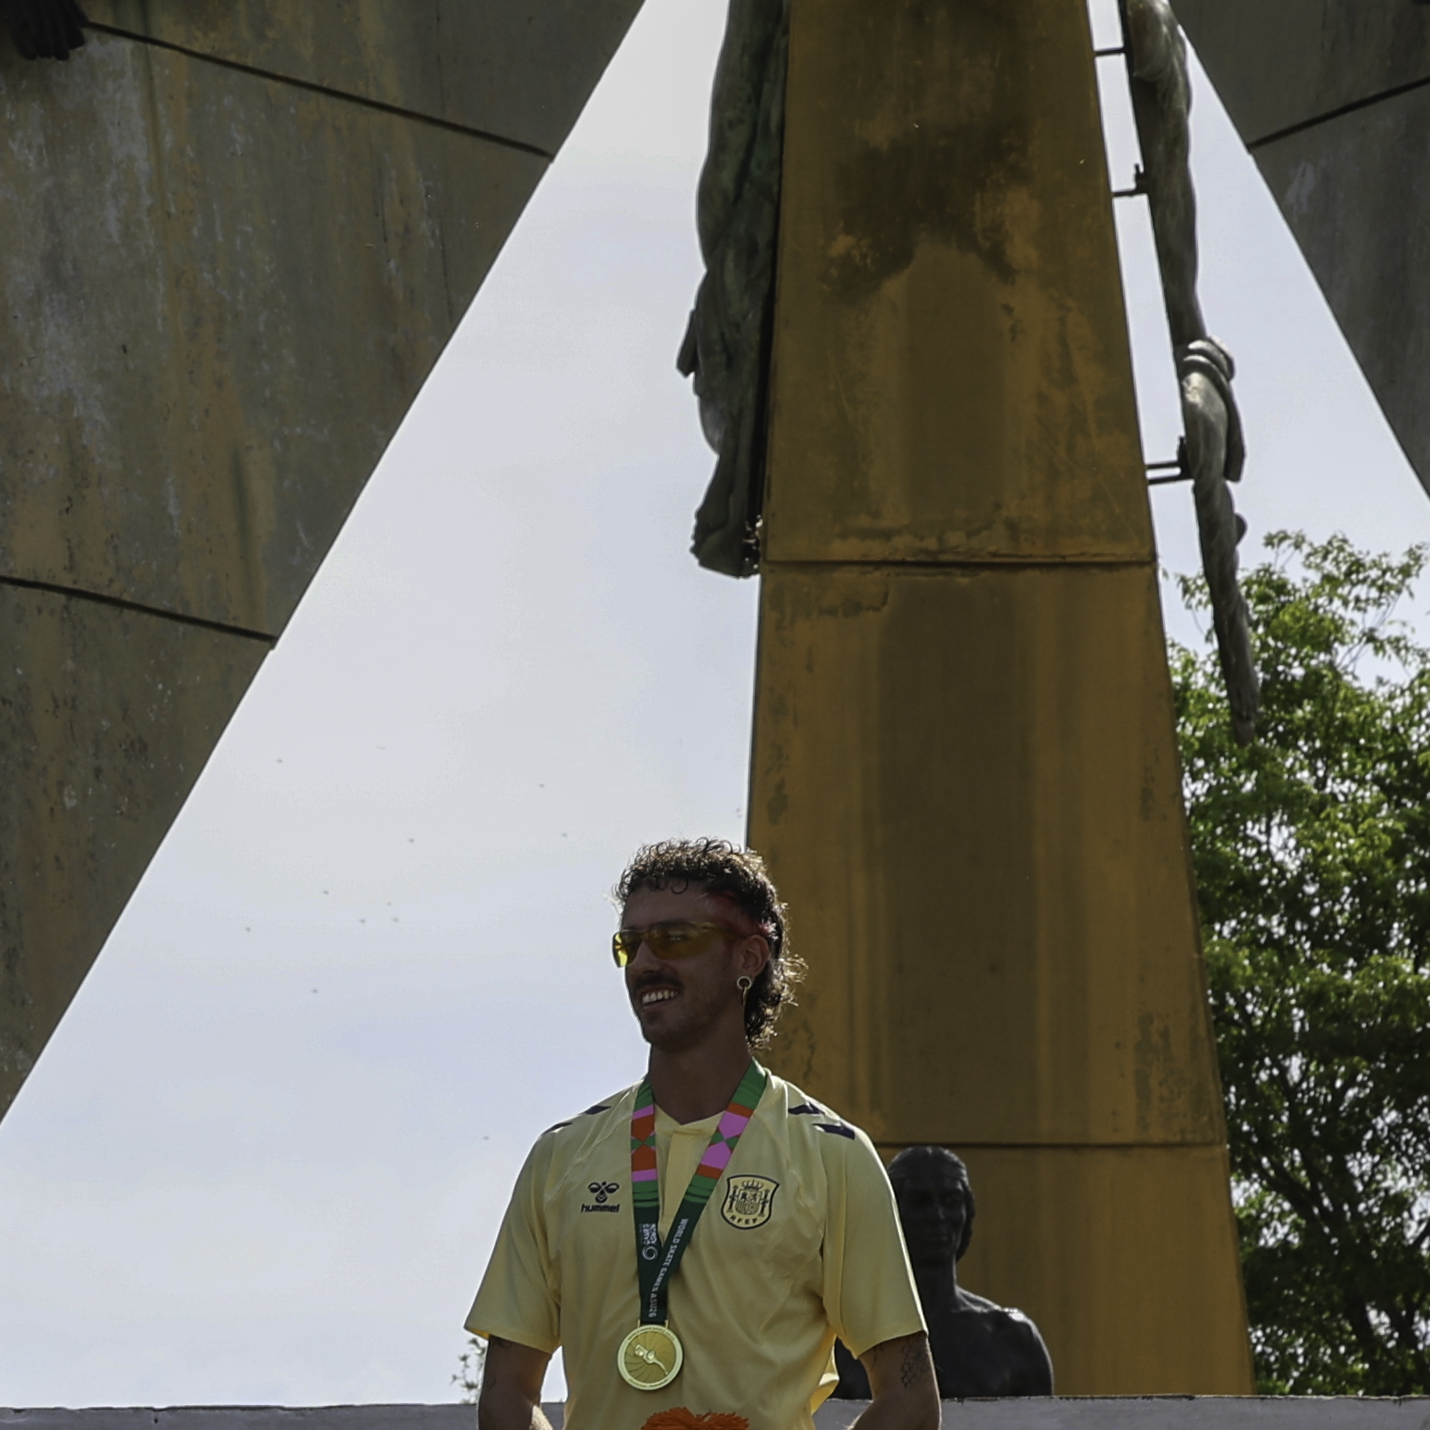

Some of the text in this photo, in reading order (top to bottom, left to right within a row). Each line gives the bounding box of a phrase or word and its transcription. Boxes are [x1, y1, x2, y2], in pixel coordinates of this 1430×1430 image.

[581, 1203, 620, 1213] hummel
[672, 1218, 689, 1244] WORLD
[662, 1244, 677, 1267] SKATE
